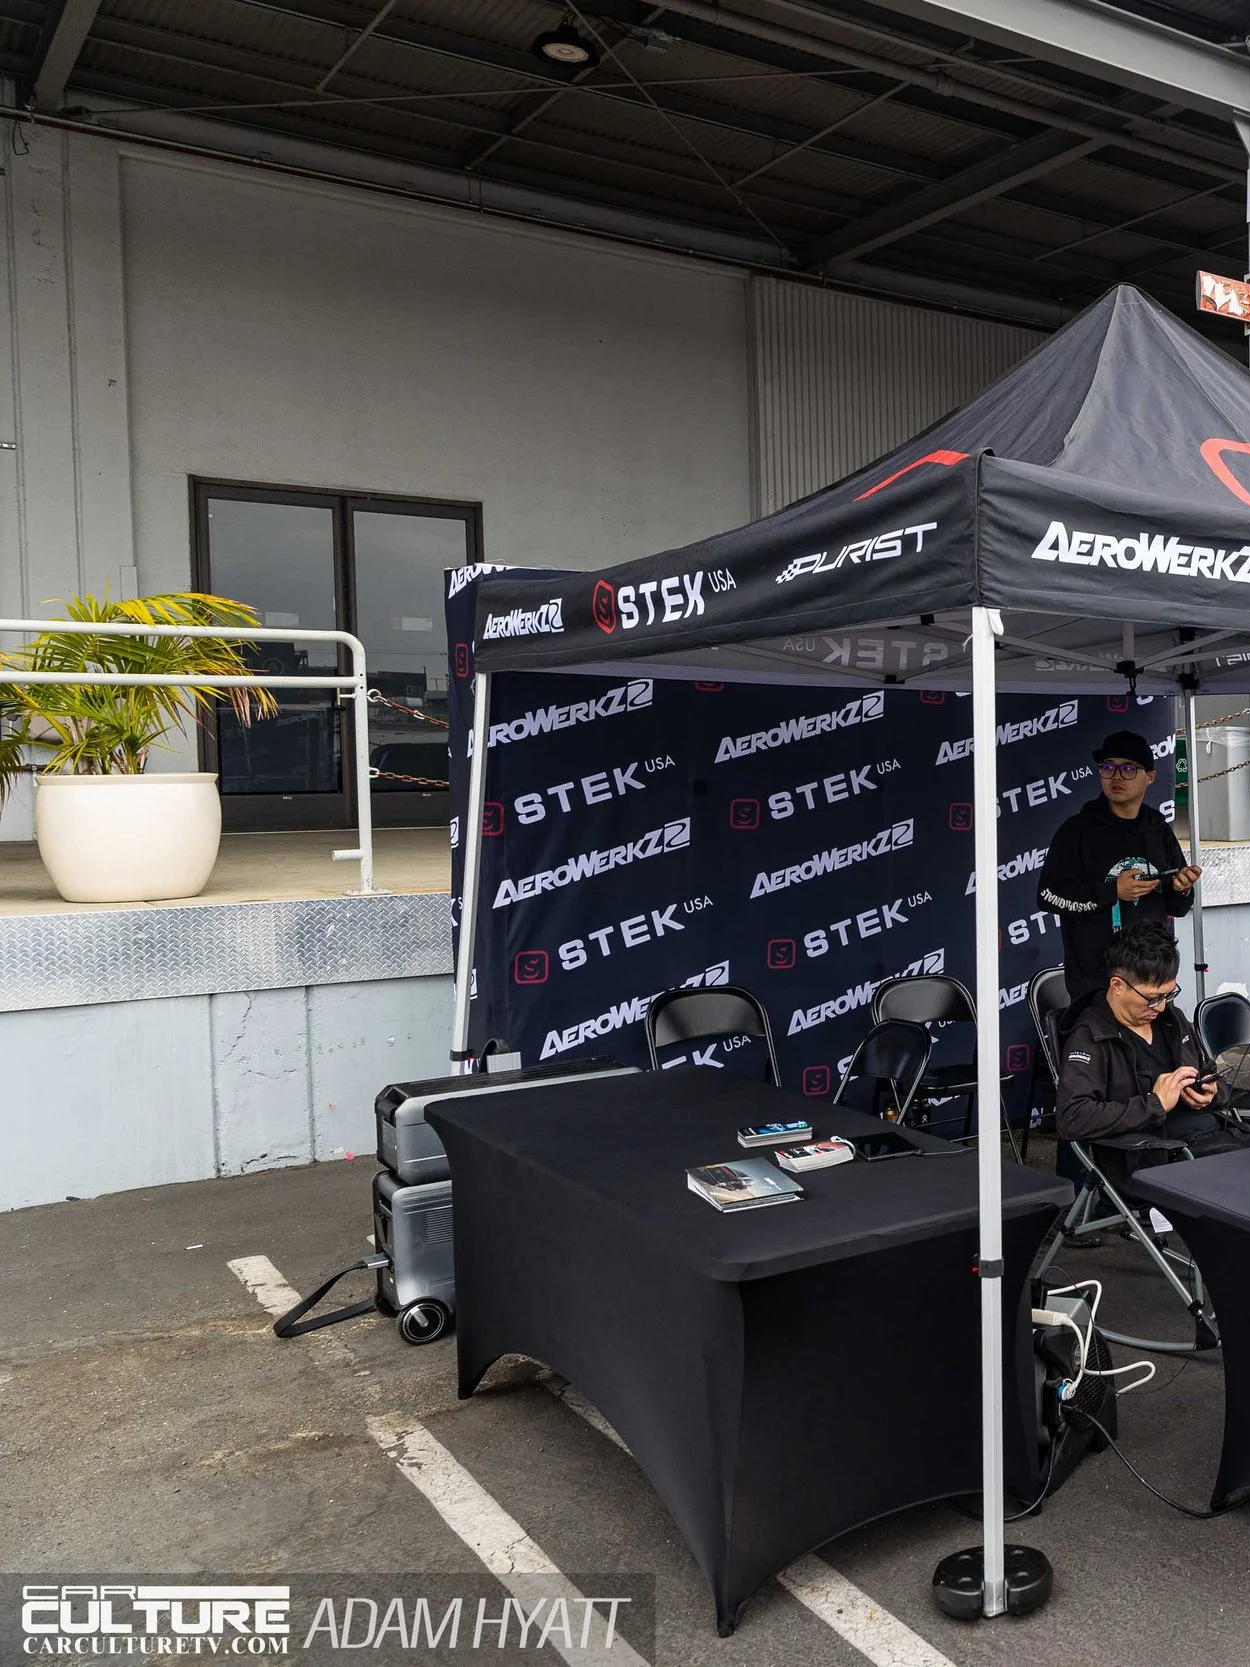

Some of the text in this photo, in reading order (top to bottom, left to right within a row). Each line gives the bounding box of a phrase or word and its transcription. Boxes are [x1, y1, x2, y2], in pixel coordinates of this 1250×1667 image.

[788, 521, 938, 582] PURIST
[617, 567, 737, 629] STEK USA
[514, 755, 676, 824] STEK USA
[768, 758, 901, 820] STEK USA
[1071, 765, 1093, 781] USA
[558, 895, 714, 971] STEK USA
[803, 891, 933, 958] STEK USA
[723, 1035, 752, 1053] USA
